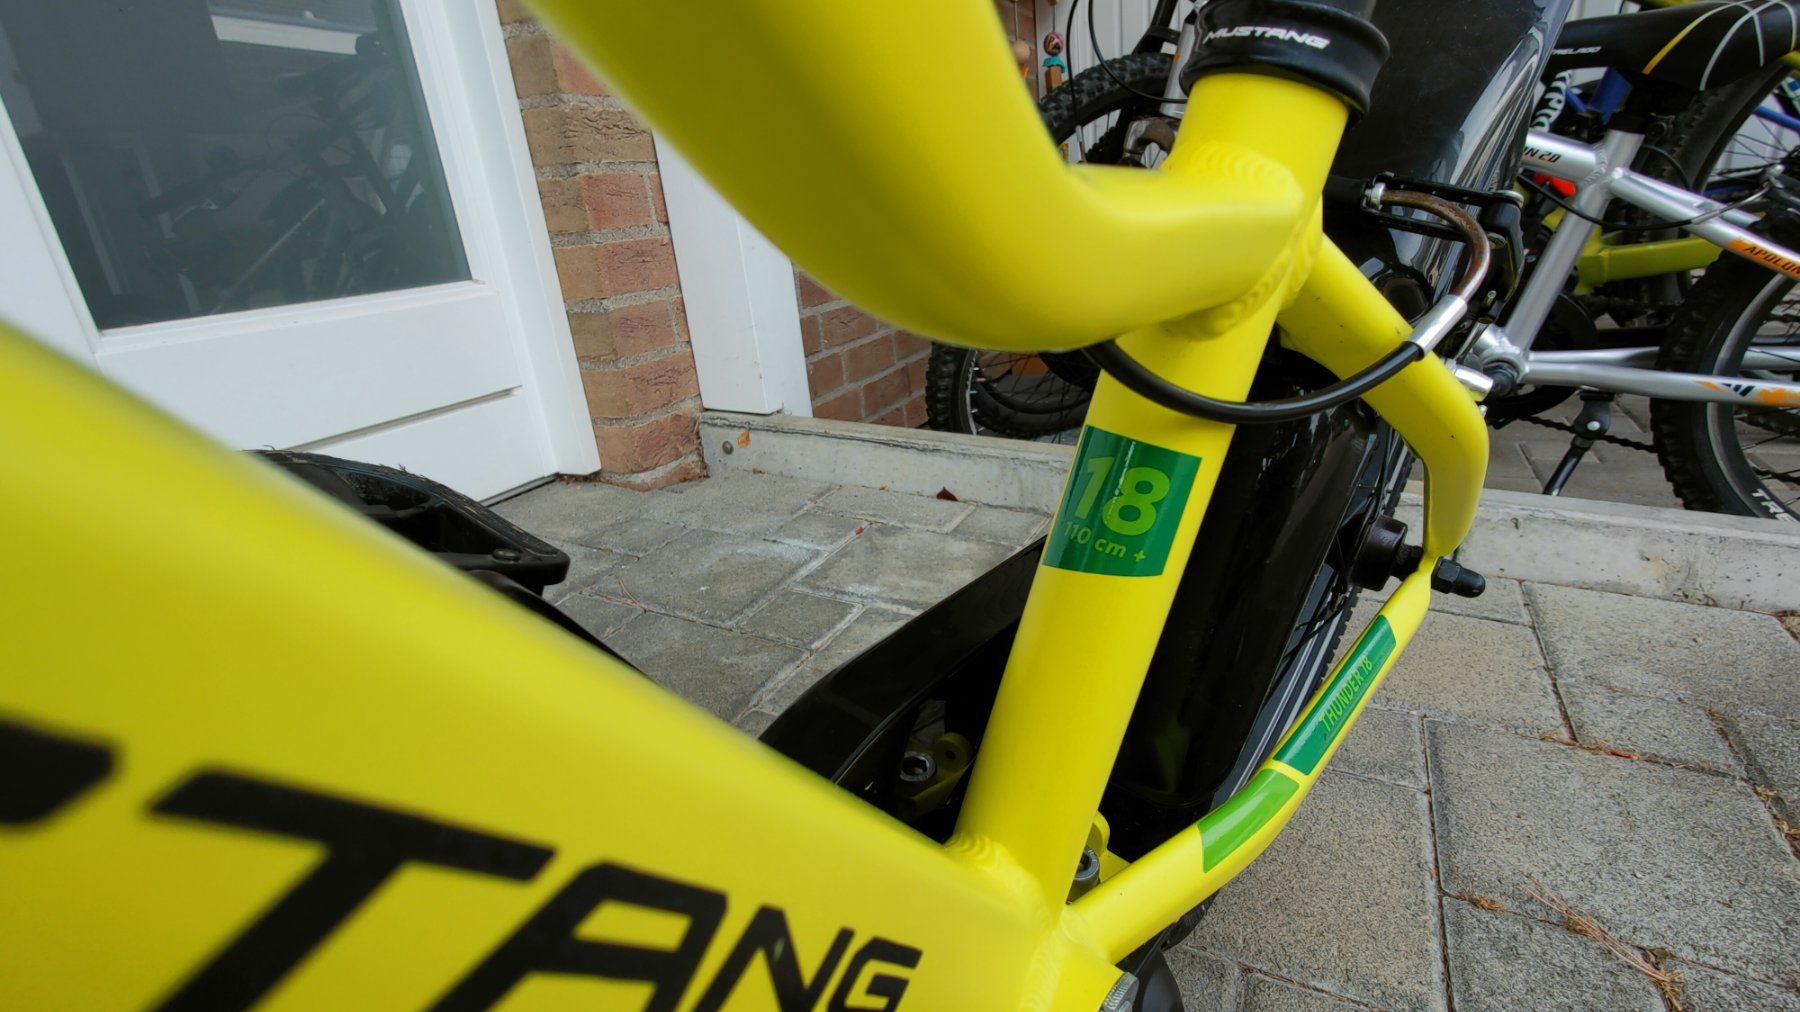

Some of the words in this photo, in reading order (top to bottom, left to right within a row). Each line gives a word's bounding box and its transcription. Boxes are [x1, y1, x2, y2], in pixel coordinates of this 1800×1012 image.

[1203, 26, 1330, 49] MUSTANG
[1075, 456, 1170, 536] 18
[1064, 521, 1092, 545] 110
[1095, 538, 1127, 558] cm
[1319, 669, 1364, 732] THUNDER
[1359, 655, 1373, 675] 18
[0, 713, 923, 1012] TANG
